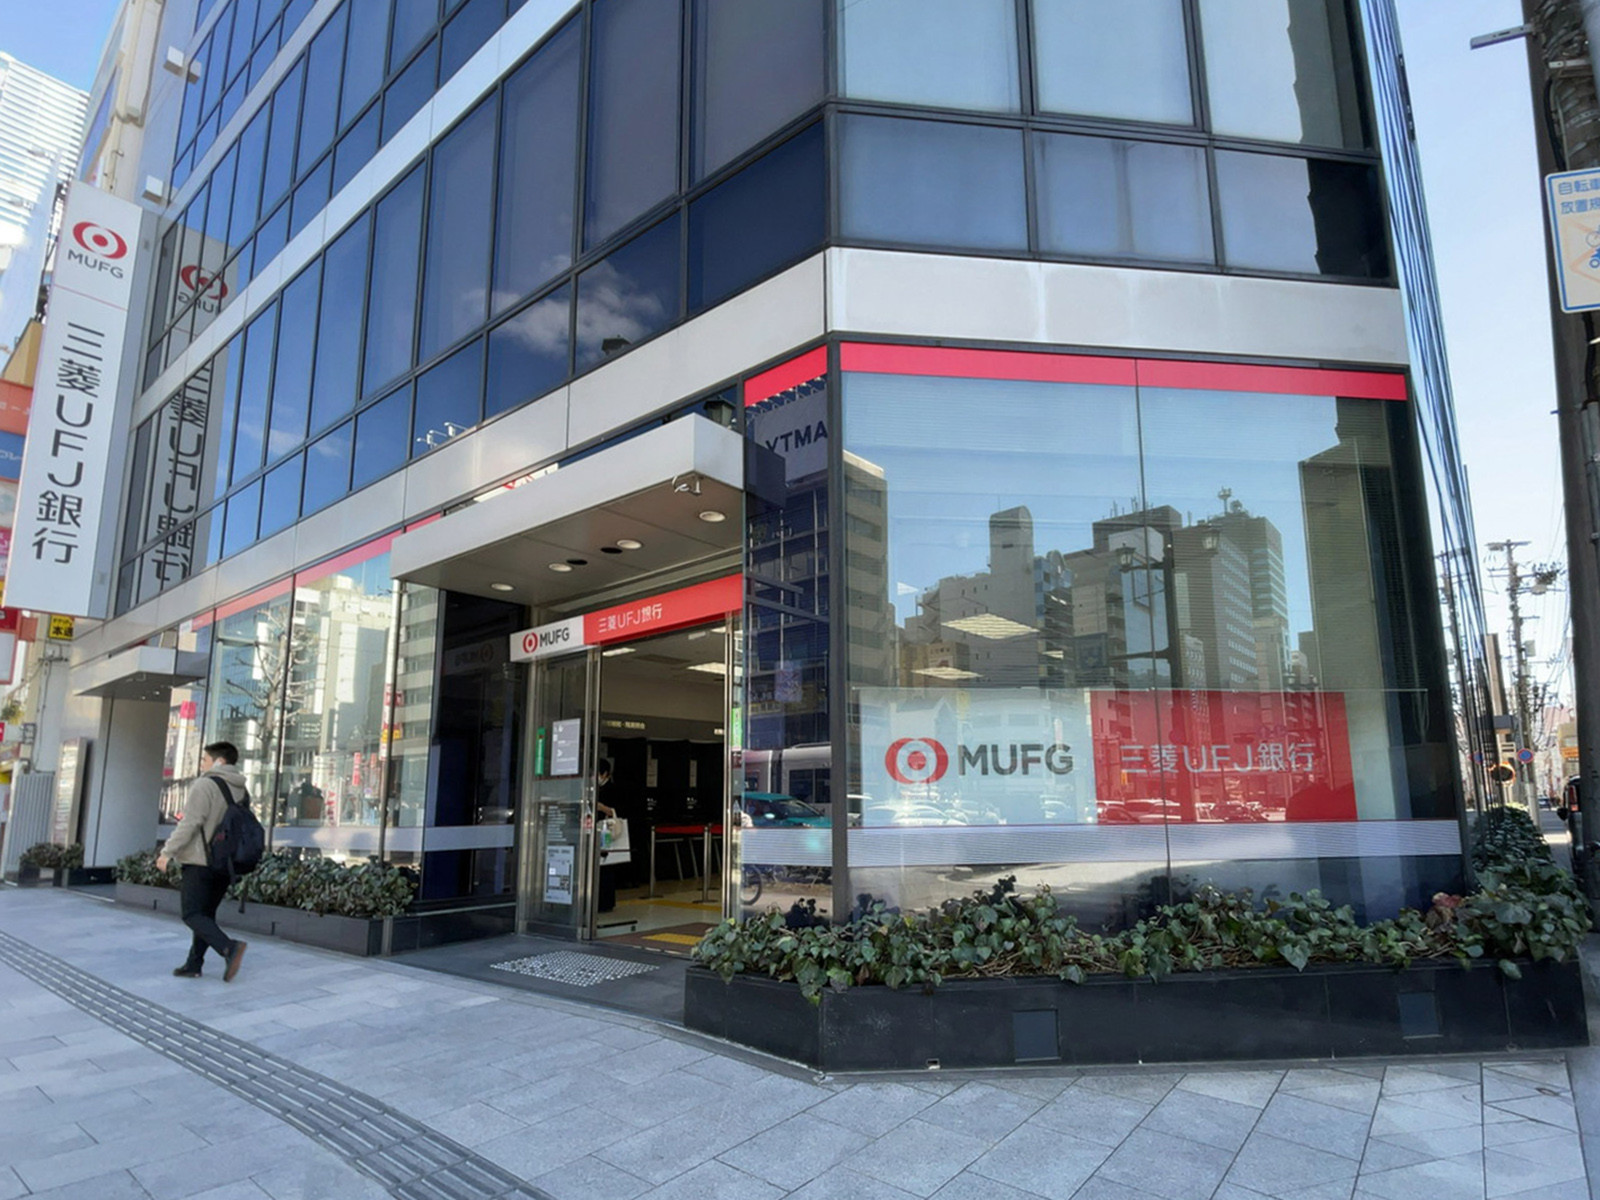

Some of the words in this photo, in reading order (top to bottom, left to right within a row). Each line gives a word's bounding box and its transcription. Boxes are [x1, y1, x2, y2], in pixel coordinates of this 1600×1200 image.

[68, 250, 124, 279] MUFG
[32, 321, 105, 564] 三菱UFJ銀行
[598, 604, 662, 634] 三菱UFJ銀行
[539, 627, 570, 647] MUFG
[957, 743, 1074, 776] MUFG
[1119, 741, 1315, 775] 三菱UFJ銀行
